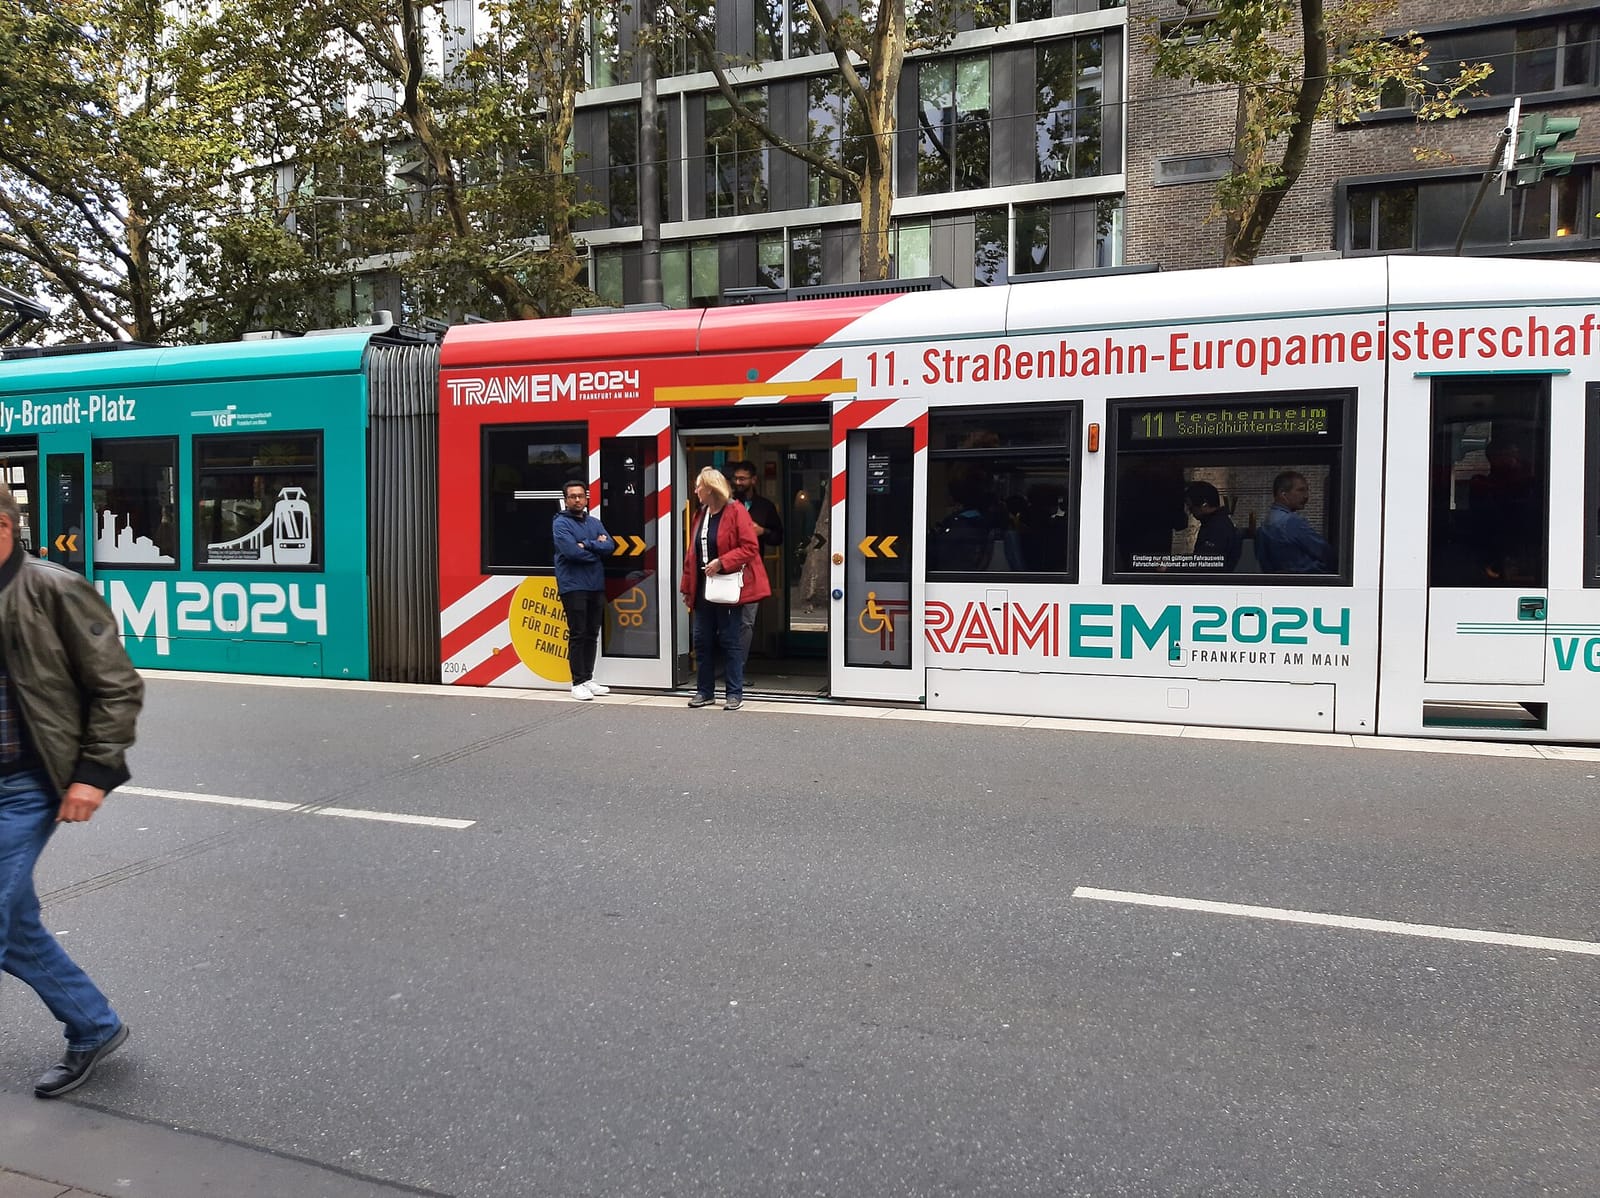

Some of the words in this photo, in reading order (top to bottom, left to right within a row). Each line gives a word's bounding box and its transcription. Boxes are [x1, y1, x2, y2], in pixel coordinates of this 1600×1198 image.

[867, 350, 909, 387] 11.
[922, 313, 1600, 385] Straßenbahn-Europameisterschaf
[579, 370, 639, 391] 2024
[579, 392, 612, 401] FRANKFURT
[1142, 411, 1164, 438] 11
[1175, 407, 1327, 423] Fechenheim
[95, 580, 170, 655] M
[176, 581, 327, 636] 2024
[522, 616, 541, 632] FÜR
[544, 623, 560, 639] DIE
[1192, 605, 1350, 646] 2024
[444, 662, 460, 673] 230
[461, 663, 468, 673] A
[1191, 650, 1277, 665] FRANKFURT
[1283, 652, 1304, 665] AM
[1312, 653, 1350, 667] MAIN
